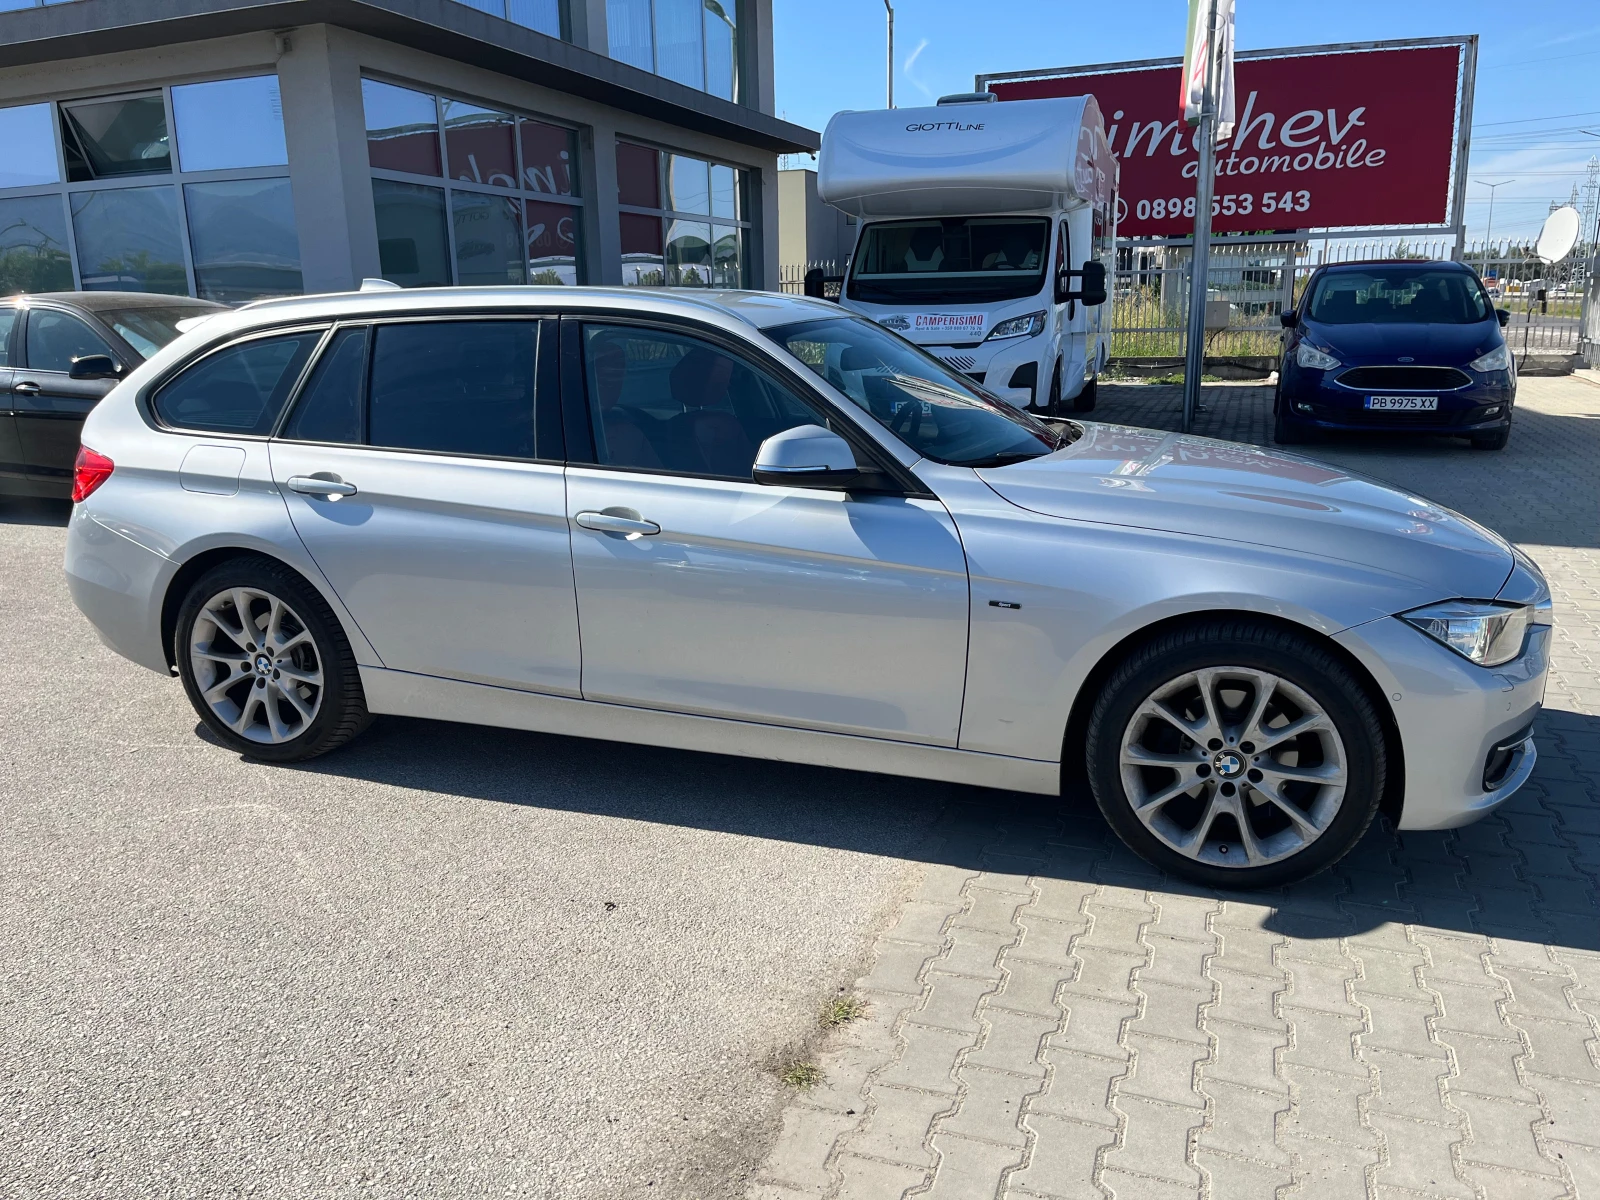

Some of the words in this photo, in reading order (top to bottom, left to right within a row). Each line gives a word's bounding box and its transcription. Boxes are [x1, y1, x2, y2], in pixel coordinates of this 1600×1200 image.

[1136, 196, 1197, 220] 0898
[1261, 190, 1311, 214] 543
[915, 314, 984, 326] CAMPERISIMO
[1371, 397, 1387, 408] PB
[1390, 398, 1418, 409] 9975
[1420, 398, 1436, 409] XX
